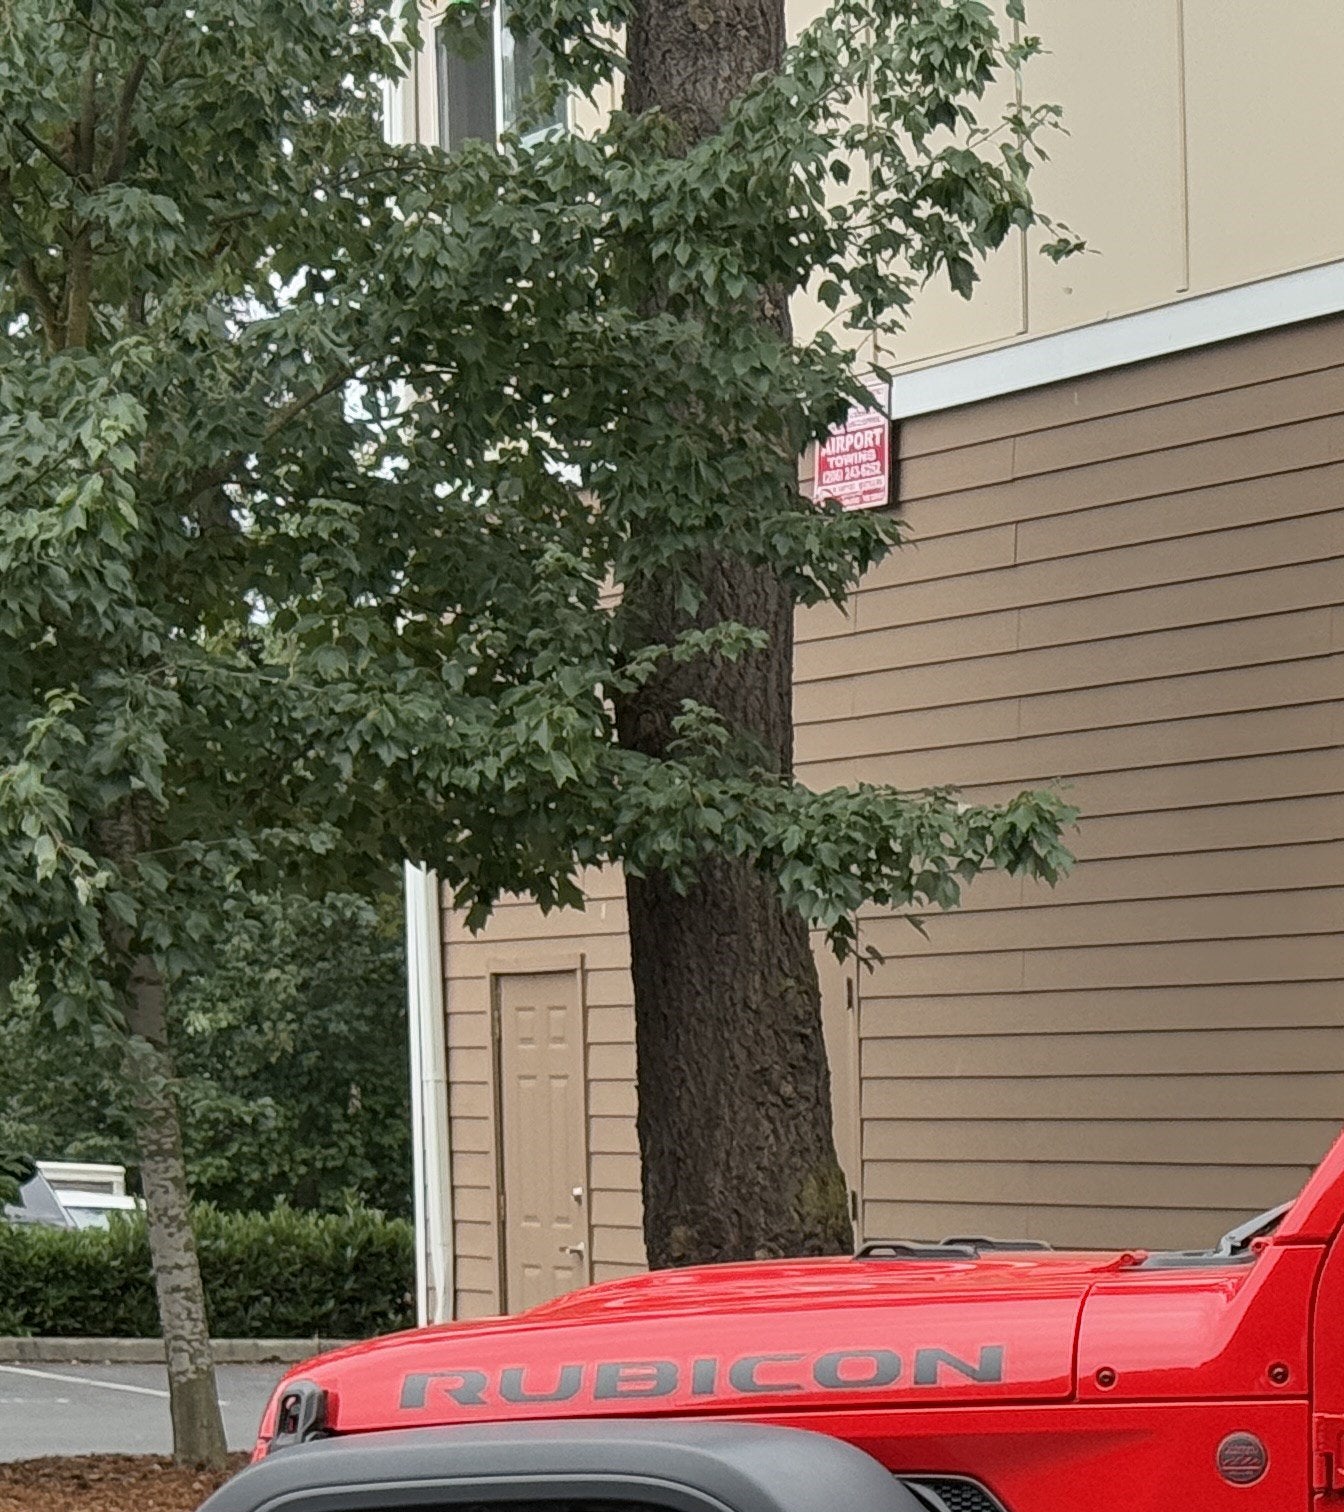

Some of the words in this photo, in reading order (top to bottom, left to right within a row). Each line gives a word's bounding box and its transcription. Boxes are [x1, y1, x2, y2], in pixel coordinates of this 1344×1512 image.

[821, 428, 883, 457] AIRPORT
[827, 449, 877, 468] TOWING
[400, 1345, 1005, 1409] RUBICON
